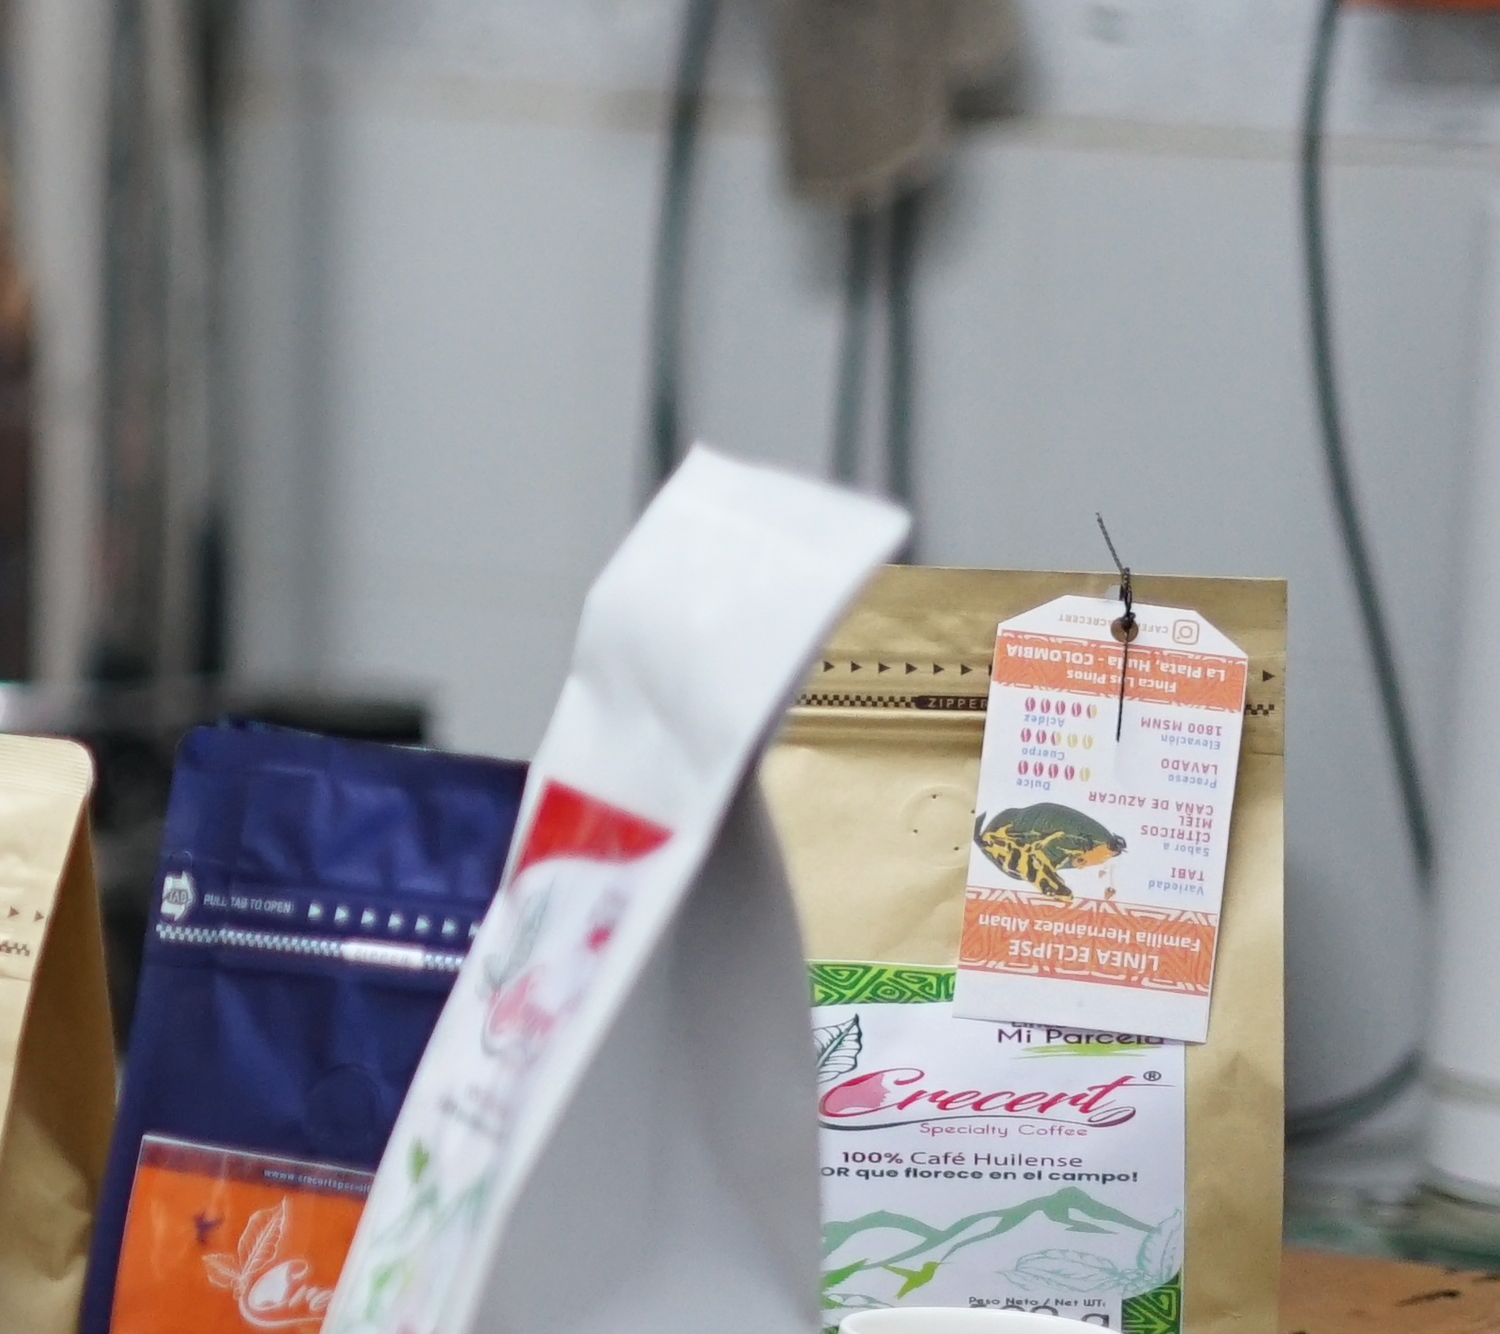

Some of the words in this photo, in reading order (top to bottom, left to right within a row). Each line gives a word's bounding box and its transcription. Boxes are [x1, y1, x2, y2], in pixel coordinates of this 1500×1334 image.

[1005, 643, 1095, 666] COLOMBIA
[1066, 669, 1106, 685] Pinos
[1156, 659, 1202, 680] Plata,
[1206, 666, 1226, 682] La
[1138, 677, 1178, 693] Finca
[1023, 714, 1065, 728] Acidez
[1140, 716, 1182, 732] MSNM
[1188, 723, 1223, 737] 1800
[1160, 734, 1222, 750] Elevación
[1021, 748, 1066, 761] Cuerpo
[1160, 758, 1219, 775] LAVADO
[1016, 777, 1051, 791] Dulce
[1168, 774, 1218, 789] Proceso
[1088, 789, 1147, 807] AZUCAR
[1151, 797, 1170, 810] DE
[1174, 799, 1215, 816] CAÑA
[1177, 815, 1213, 829] MIEL
[1140, 824, 1212, 844] CÍTRICOS
[1163, 842, 1170, 851] a
[1174, 843, 1211, 857] Sabor
[1170, 867, 1205, 882] TABI
[1148, 879, 1205, 896] Variedad
[203, 893, 228, 907] PULL
[229, 896, 248, 910] TAB
[249, 898, 263, 911] TO
[263, 900, 293, 915] OPEN
[978, 913, 1028, 932] Alban
[1033, 919, 1131, 945] Hernández
[1135, 931, 1201, 953] Familia
[1008, 939, 1091, 964] ECLIPSE
[1098, 949, 1159, 972] LÍNEA
[998, 1028, 1032, 1045] Mi
[818, 1067, 1140, 1119] Crecert
[919, 1121, 1009, 1139] Specialty
[1018, 1123, 1088, 1137] Coffee
[842, 1150, 904, 1165] 100%
[910, 1149, 966, 1166] Café
[973, 1152, 1084, 1169] Huilense
[855, 1168, 900, 1182] que
[904, 1166, 984, 1181] florece
[989, 1170, 1018, 1181] en
[1022, 1168, 1043, 1182] el
[1047, 1171, 1139, 1186] campo!
[968, 1296, 1001, 1307] Peso
[1005, 1297, 1039, 1307] Neto
[1041, 1298, 1051, 1308] /
[1054, 1298, 1079, 1308] Net
